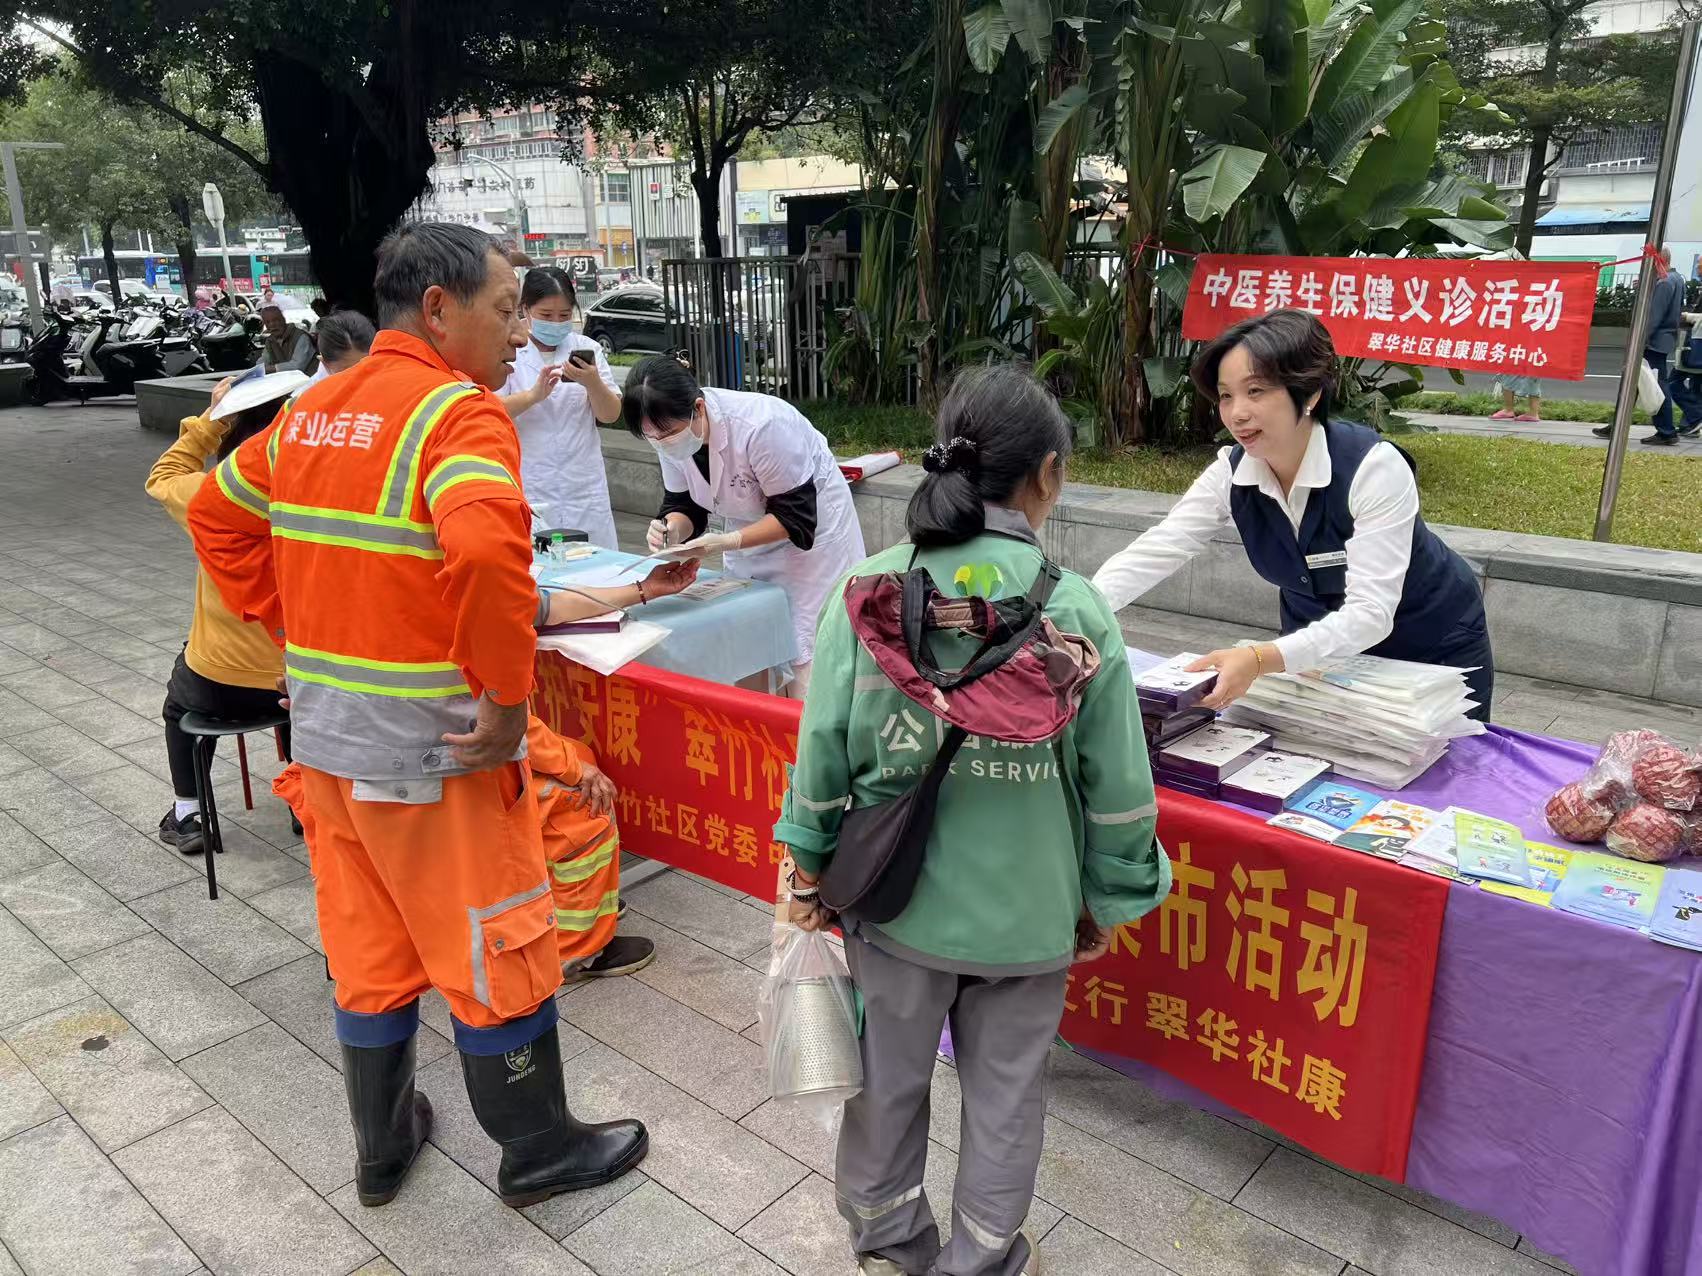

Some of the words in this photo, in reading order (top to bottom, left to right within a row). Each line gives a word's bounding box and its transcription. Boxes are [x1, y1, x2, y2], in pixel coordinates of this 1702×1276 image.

[1203, 268, 1564, 332] 中医养生保健义诊活动
[1366, 331, 1548, 368] 翠华社区健康服务中心
[970, 758, 1059, 783] SERVIC
[1145, 990, 1348, 1121] 翠华社康
